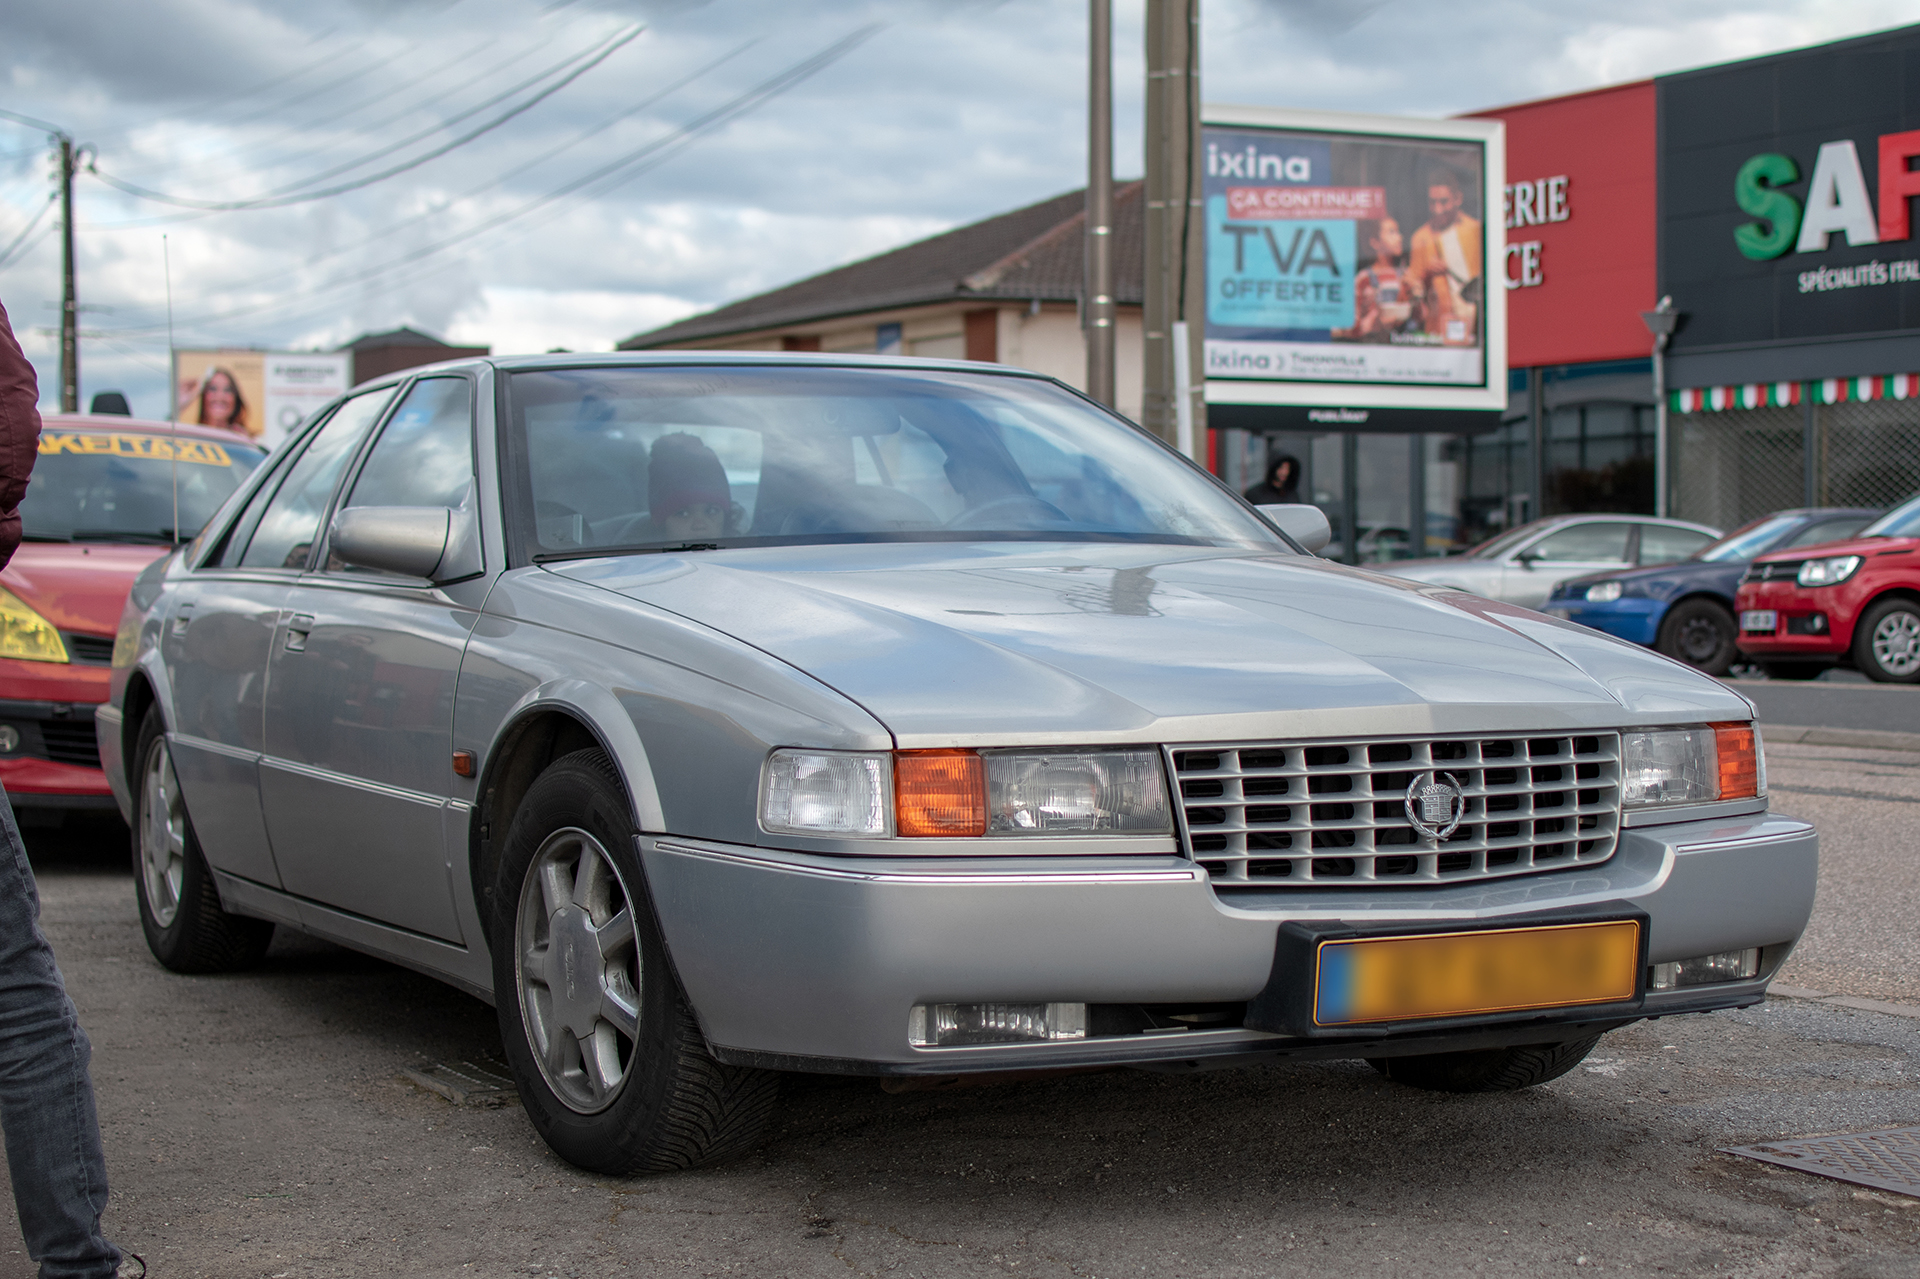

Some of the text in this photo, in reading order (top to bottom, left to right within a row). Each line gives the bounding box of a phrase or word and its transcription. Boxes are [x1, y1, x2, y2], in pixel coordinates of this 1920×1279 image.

[1207, 143, 1311, 182] ixina
[1229, 189, 1260, 212] ÇA
[1263, 190, 1372, 209] CONTINUE
[1222, 224, 1341, 277] TVA
[1798, 259, 1889, 293] SPÉCIALITÉS
[1220, 278, 1342, 303] OFFERTE
[1209, 351, 1270, 370] ixina
[121, 435, 219, 462] TAXI
